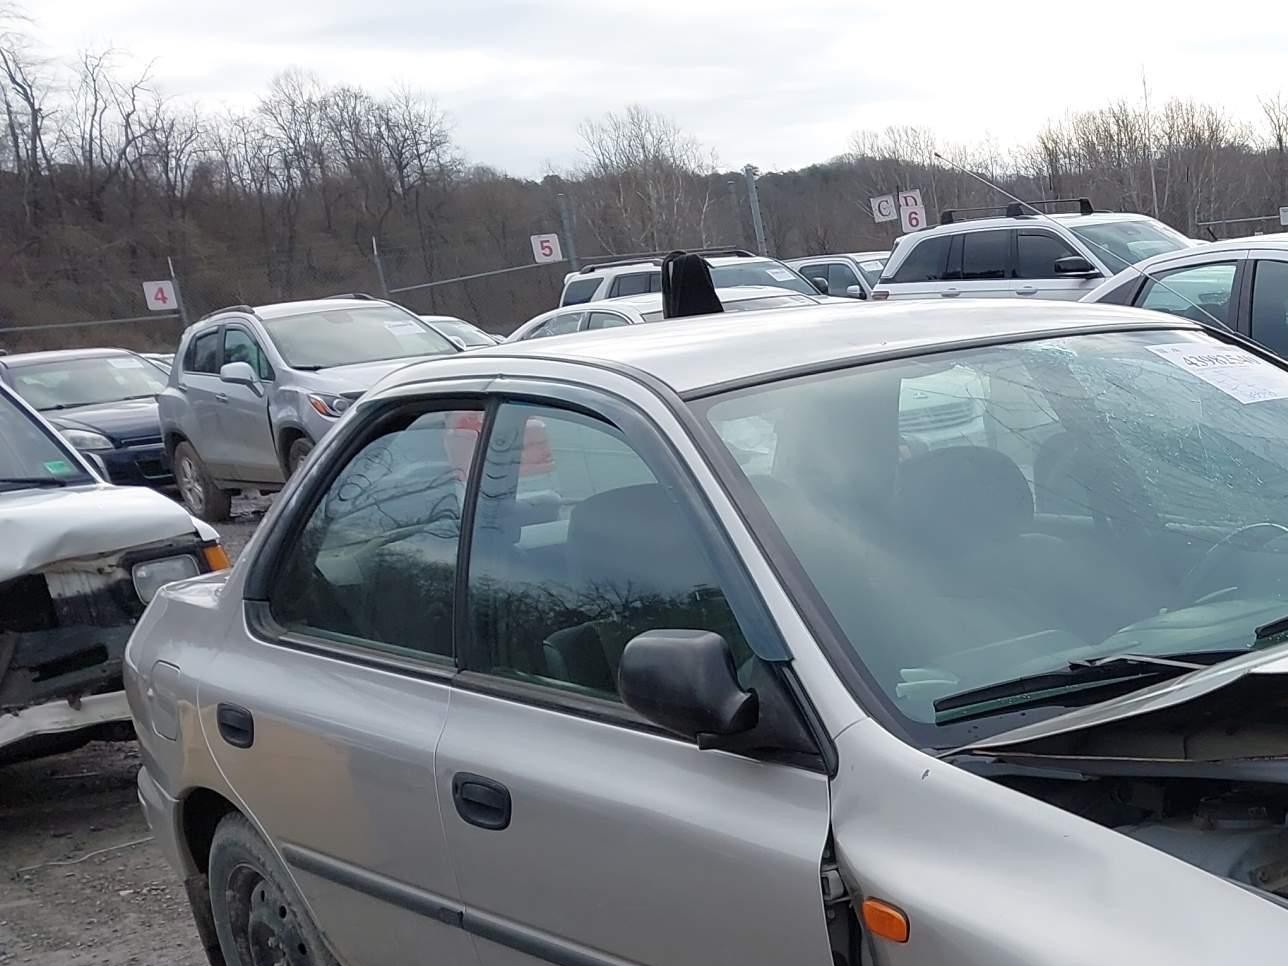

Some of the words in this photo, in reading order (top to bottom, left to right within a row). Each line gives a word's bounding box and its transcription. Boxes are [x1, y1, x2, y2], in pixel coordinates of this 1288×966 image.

[877, 199, 891, 217] C
[908, 210, 920, 228] 6
[540, 239, 554, 257] 5
[154, 287, 169, 305] 4
